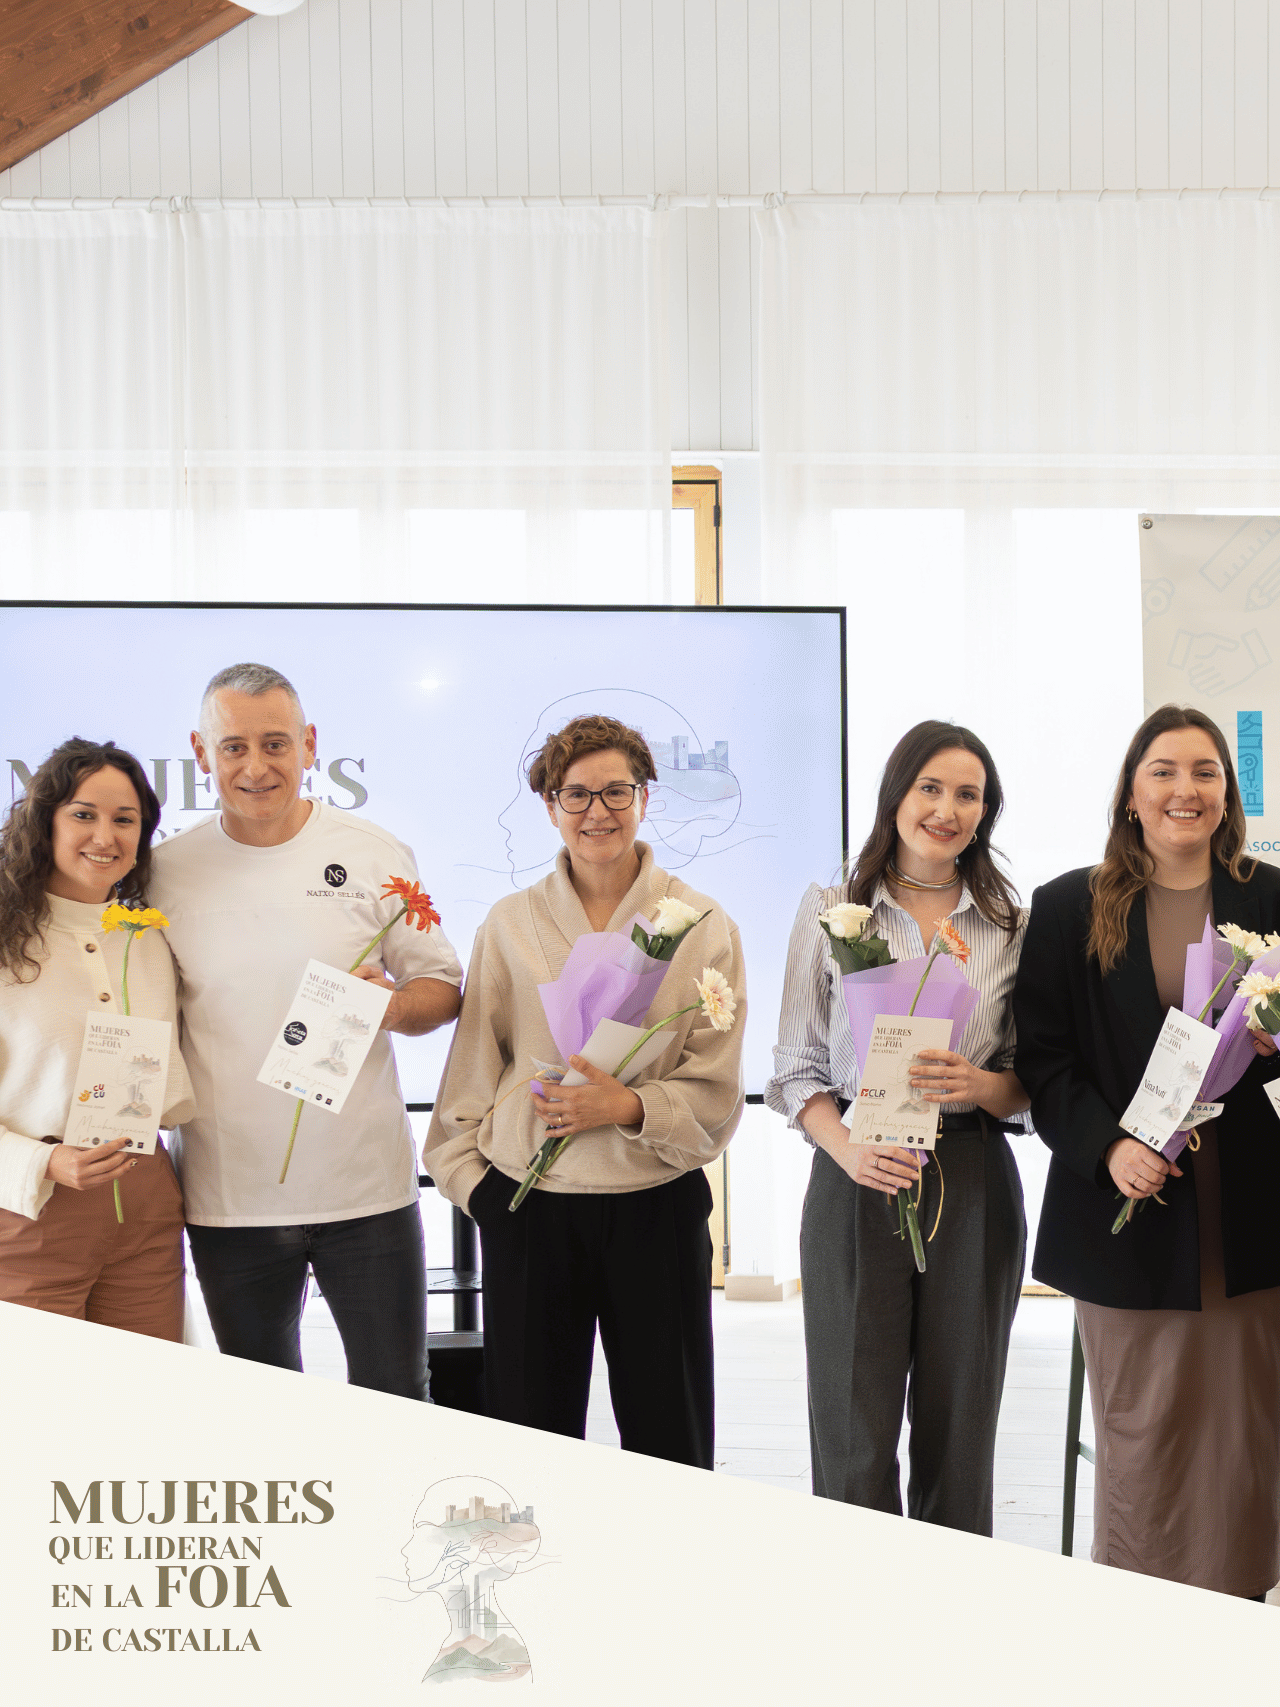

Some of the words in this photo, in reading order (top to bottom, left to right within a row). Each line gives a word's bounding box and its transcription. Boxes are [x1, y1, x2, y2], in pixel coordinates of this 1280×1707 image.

[326, 868, 345, 883] NS
[306, 889, 335, 897] NATXO
[875, 1027, 912, 1036] MUJERES
[867, 1088, 886, 1098] CLR
